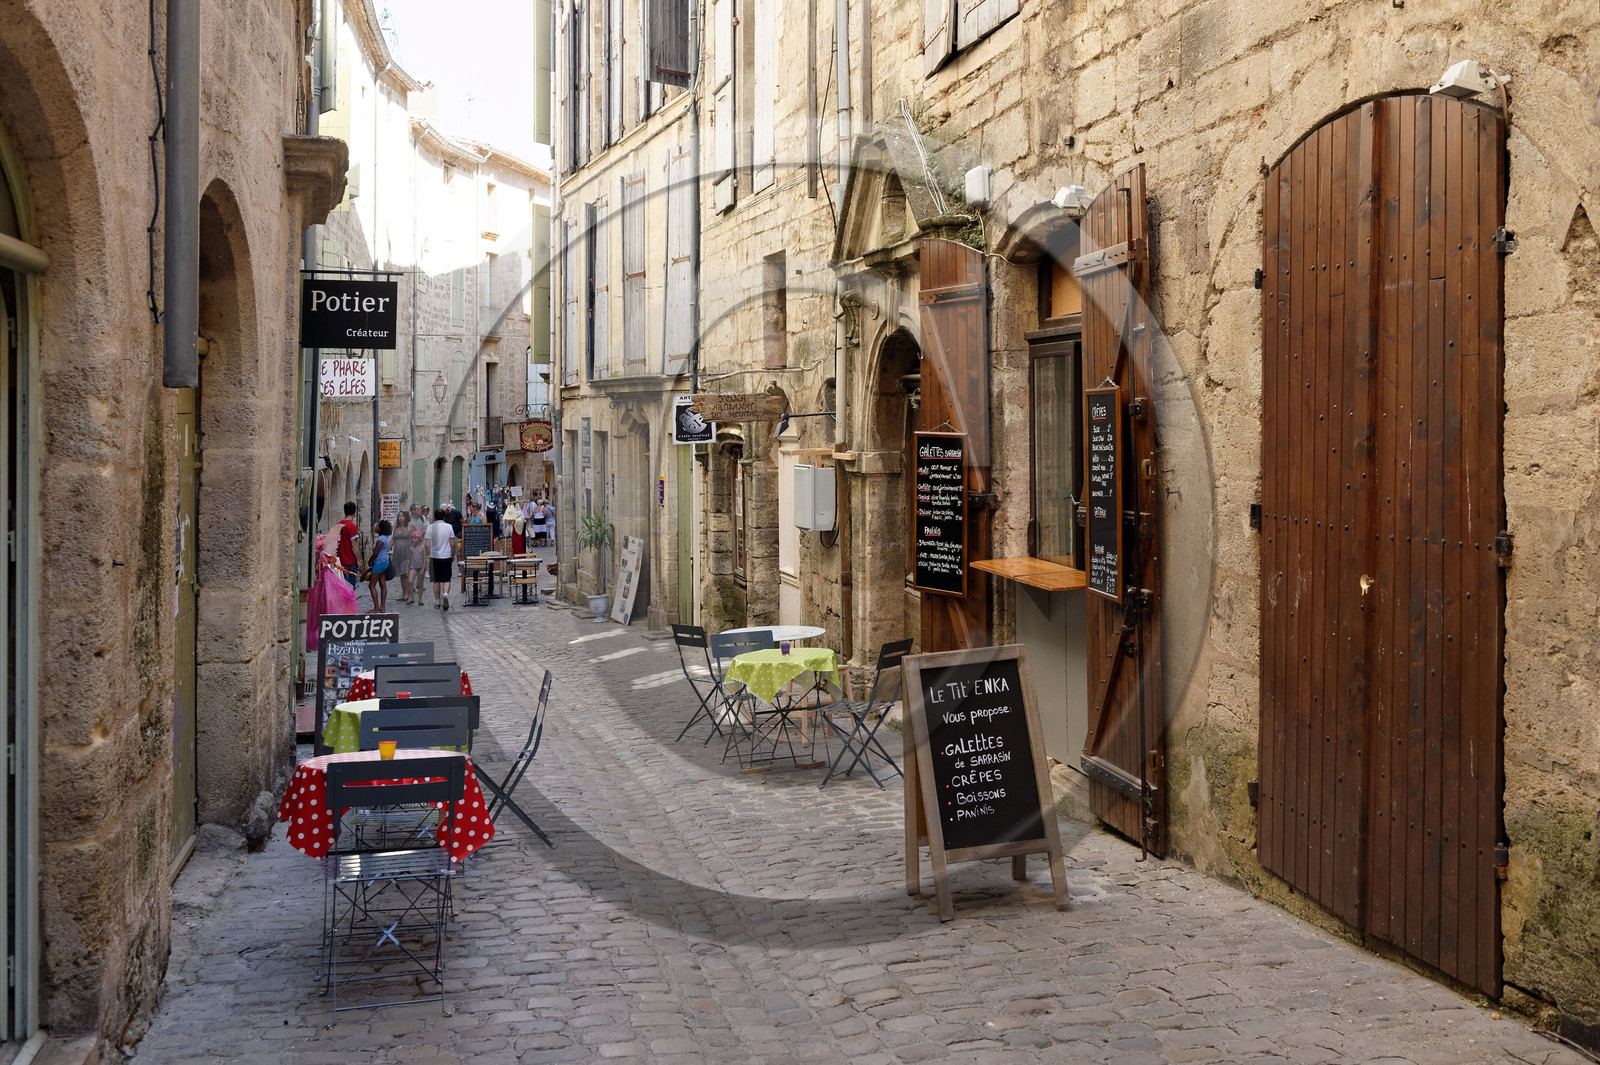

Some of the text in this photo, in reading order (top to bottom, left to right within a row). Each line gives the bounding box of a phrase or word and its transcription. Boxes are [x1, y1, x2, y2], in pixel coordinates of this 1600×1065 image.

[311, 290, 390, 313] Potier
[346, 328, 389, 337] Créateur
[321, 360, 367, 377] E PHARE
[320, 378, 367, 396] ES ELFES
[320, 616, 394, 638] POTIER
[974, 678, 1010, 695] ENKA
[954, 757, 966, 769] de
[951, 769, 1002, 787] CRÊPES
